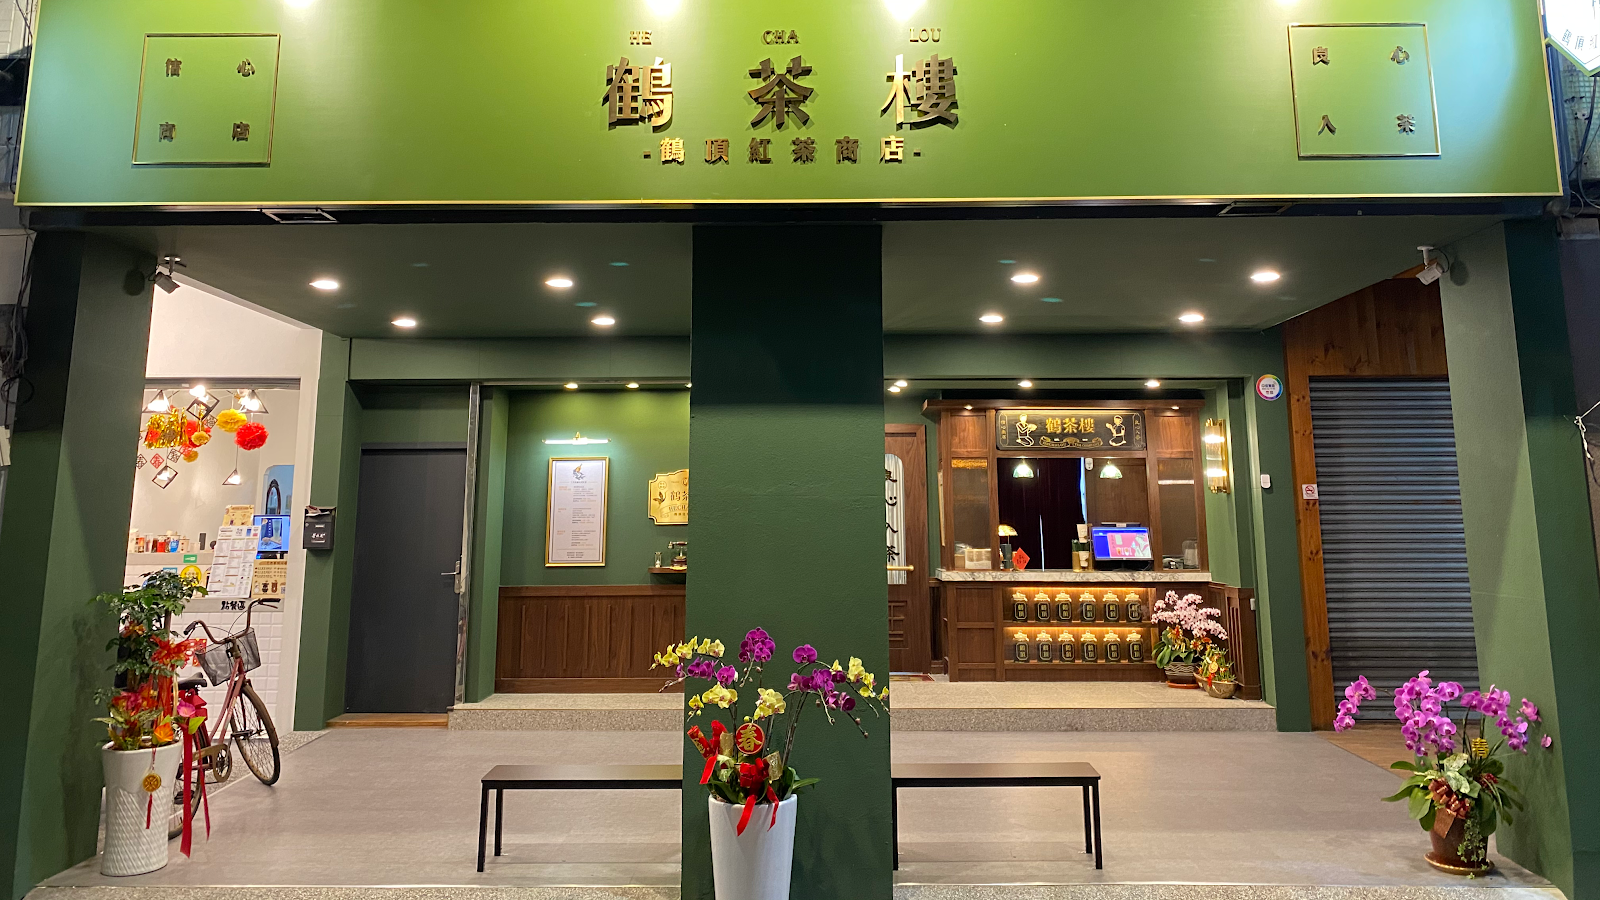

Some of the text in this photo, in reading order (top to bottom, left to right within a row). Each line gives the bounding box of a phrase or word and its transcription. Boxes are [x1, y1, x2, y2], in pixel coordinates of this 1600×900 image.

[629, 27, 942, 46] HE CHA LOU
[601, 53, 960, 133] 鶴茶樓
[659, 135, 906, 165] 鶴頂紅茶商店
[1045, 417, 1095, 434] 鶴茶樓
[221, 600, 246, 611] 點餐區
[738, 725, 763, 752] 春
